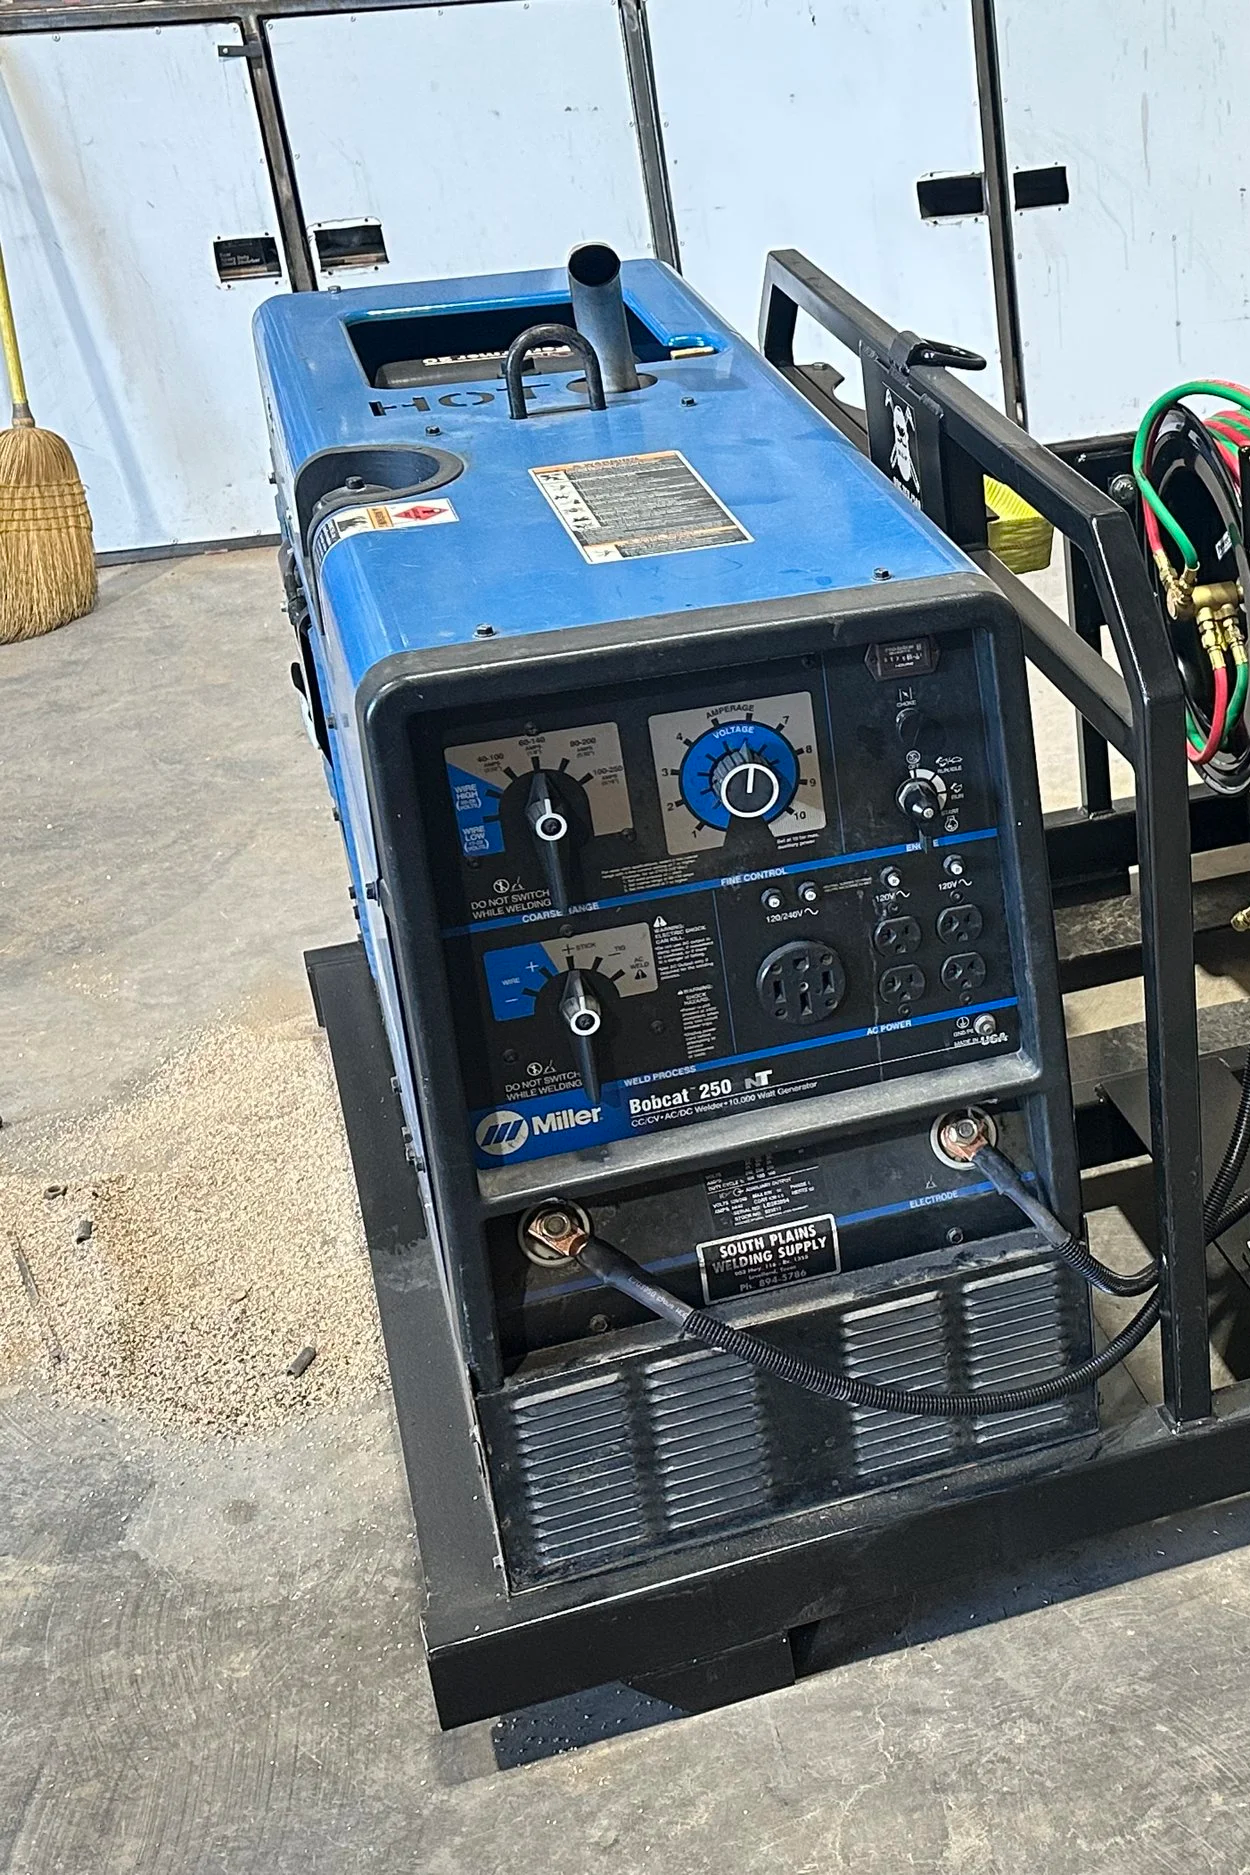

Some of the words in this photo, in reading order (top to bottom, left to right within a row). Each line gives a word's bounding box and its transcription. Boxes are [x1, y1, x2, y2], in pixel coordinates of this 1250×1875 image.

[896, 700, 917, 708] CHOKE
[705, 704, 755, 719] AMPERAGE
[783, 715, 790, 724] 7
[676, 732, 683, 741] 4
[713, 726, 755, 739] VOLTAGE
[518, 736, 546, 747] 60-140
[569, 737, 597, 748] 80-200
[805, 745, 812, 754] 8
[476, 752, 504, 763] 40-100
[593, 765, 623, 776] 100-250
[661, 767, 669, 776] 3
[454, 784, 477, 793] WIRE
[456, 791, 479, 800] HIGH
[667, 803, 674, 811] 2
[940, 807, 959, 816] START
[794, 811, 806, 820] 10
[462, 825, 485, 834] WIRE
[692, 830, 697, 838] 1
[465, 833, 485, 841] LOW
[720, 872, 743, 886] FINE
[743, 866, 789, 882] CONTROL
[938, 880, 957, 890] 120V
[471, 901, 487, 910] DO
[488, 896, 509, 908] NOT
[511, 889, 551, 903] SWITCH
[875, 892, 896, 903] 120V
[472, 907, 504, 920] WHILE
[506, 898, 552, 915] WELDING
[522, 909, 563, 924] COARSE
[766, 908, 804, 923] 120/240V
[575, 942, 597, 950] STICK
[630, 961, 650, 969] WELD
[501, 976, 521, 986] WIRE
[866, 1026, 879, 1036] AC
[880, 1019, 912, 1033] POWER
[953, 1037, 969, 1047] MADE
[506, 1082, 521, 1092] DO
[523, 1078, 543, 1090] NOT
[544, 1071, 581, 1085] SWITCH
[624, 1074, 651, 1087] WELD
[653, 1065, 697, 1082] PROCESS
[506, 1089, 538, 1101] WHILE
[539, 1079, 583, 1096] WELDING
[629, 1088, 690, 1114] Bobcat
[699, 1079, 732, 1100] 250
[744, 1069, 773, 1089] NT
[757, 1089, 776, 1100] Watt
[777, 1080, 818, 1095] Generator
[532, 1105, 601, 1135] Miller
[909, 1189, 959, 1209] ELECTRODE
[719, 1236, 765, 1259] SOUTH
[769, 1224, 817, 1247] PLAINS
[712, 1250, 773, 1274] WELDING
[778, 1236, 827, 1258] SUPPLY
[739, 1282, 754, 1292] Ph.
[759, 1269, 807, 1287] 894-5786
